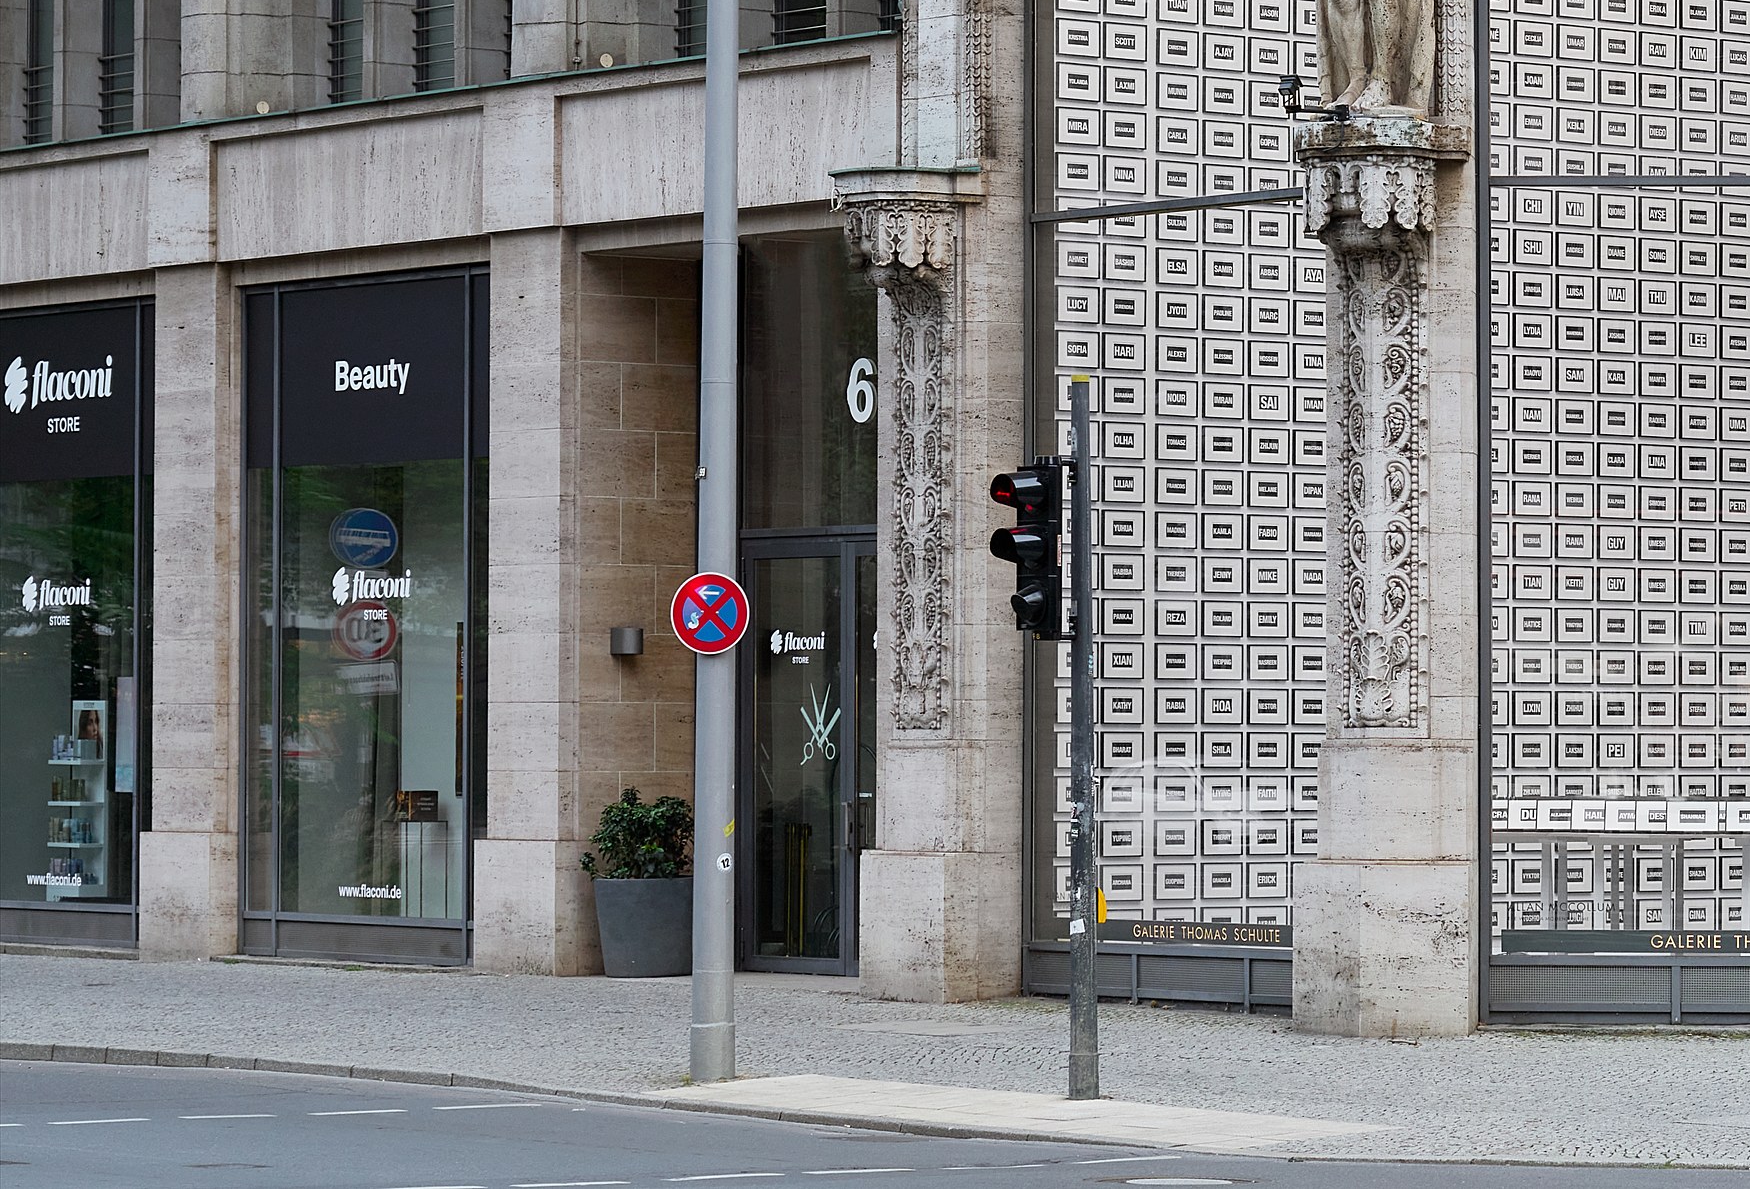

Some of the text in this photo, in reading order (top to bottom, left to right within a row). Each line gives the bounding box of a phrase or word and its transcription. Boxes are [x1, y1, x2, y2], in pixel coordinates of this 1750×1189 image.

[1115, 36, 1134, 47] SCOTT
[1567, 37, 1585, 47] UMAR
[1215, 46, 1233, 58] AJAY
[1649, 44, 1666, 56] RAVI
[1690, 47, 1707, 61] KIM
[1525, 75, 1542, 86] JOAN
[1068, 121, 1088, 132] MIRA
[1525, 117, 1542, 127] EMMA
[1115, 168, 1134, 181] NINA
[1525, 199, 1541, 213] CHI
[1567, 202, 1584, 216] YIN
[1524, 241, 1542, 254] SHU
[1167, 261, 1186, 272] ELSA
[1214, 264, 1233, 274] SAMIR
[1608, 288, 1625, 301] MAI
[1650, 291, 1666, 304] THU
[1067, 299, 1087, 310] LUCY
[1259, 310, 1278, 320] MARC
[1689, 333, 1706, 347] LEE
[1067, 344, 1087, 354] SOFIA
[1114, 345, 1134, 357] HARI
[1305, 356, 1323, 368] TINA
[335, 358, 410, 395] Beauty
[1566, 369, 1584, 381] SAM
[1608, 372, 1624, 382] KARL
[31, 355, 112, 409] flaconi
[847, 357, 874, 423] 6
[1167, 393, 1186, 403] NOUR
[1260, 396, 1277, 410] SAI
[1304, 399, 1324, 410] IMAN
[1523, 409, 1541, 420] NAM
[47, 416, 80, 433] STORE
[1729, 419, 1746, 430] UMA
[1648, 456, 1665, 467] LINA
[1729, 501, 1746, 511] PETR
[1608, 537, 1624, 549] GUY
[1258, 571, 1277, 581] MIKE
[352, 569, 411, 603] flaconi
[1525, 577, 1541, 588] TIAN
[1566, 578, 1583, 587] KEITH
[1608, 578, 1624, 590] GUY
[39, 578, 91, 610] flaconi
[49, 615, 71, 626] STORE
[363, 609, 388, 621] STORE
[1166, 613, 1185, 623] REZA
[1690, 622, 1706, 634] TIM
[783, 631, 825, 653] flaconi
[792, 656, 810, 664] STORE
[1213, 700, 1231, 712] HOA
[1608, 744, 1623, 757] PEI
[721, 857, 730, 869] 12
[26, 872, 82, 887] www.flaconi.de
[338, 883, 402, 899] www.flaconi.de
[1132, 924, 1281, 943] GALERIE THOMAS SCHULTE
[1650, 934, 1722, 949] GALERIE
